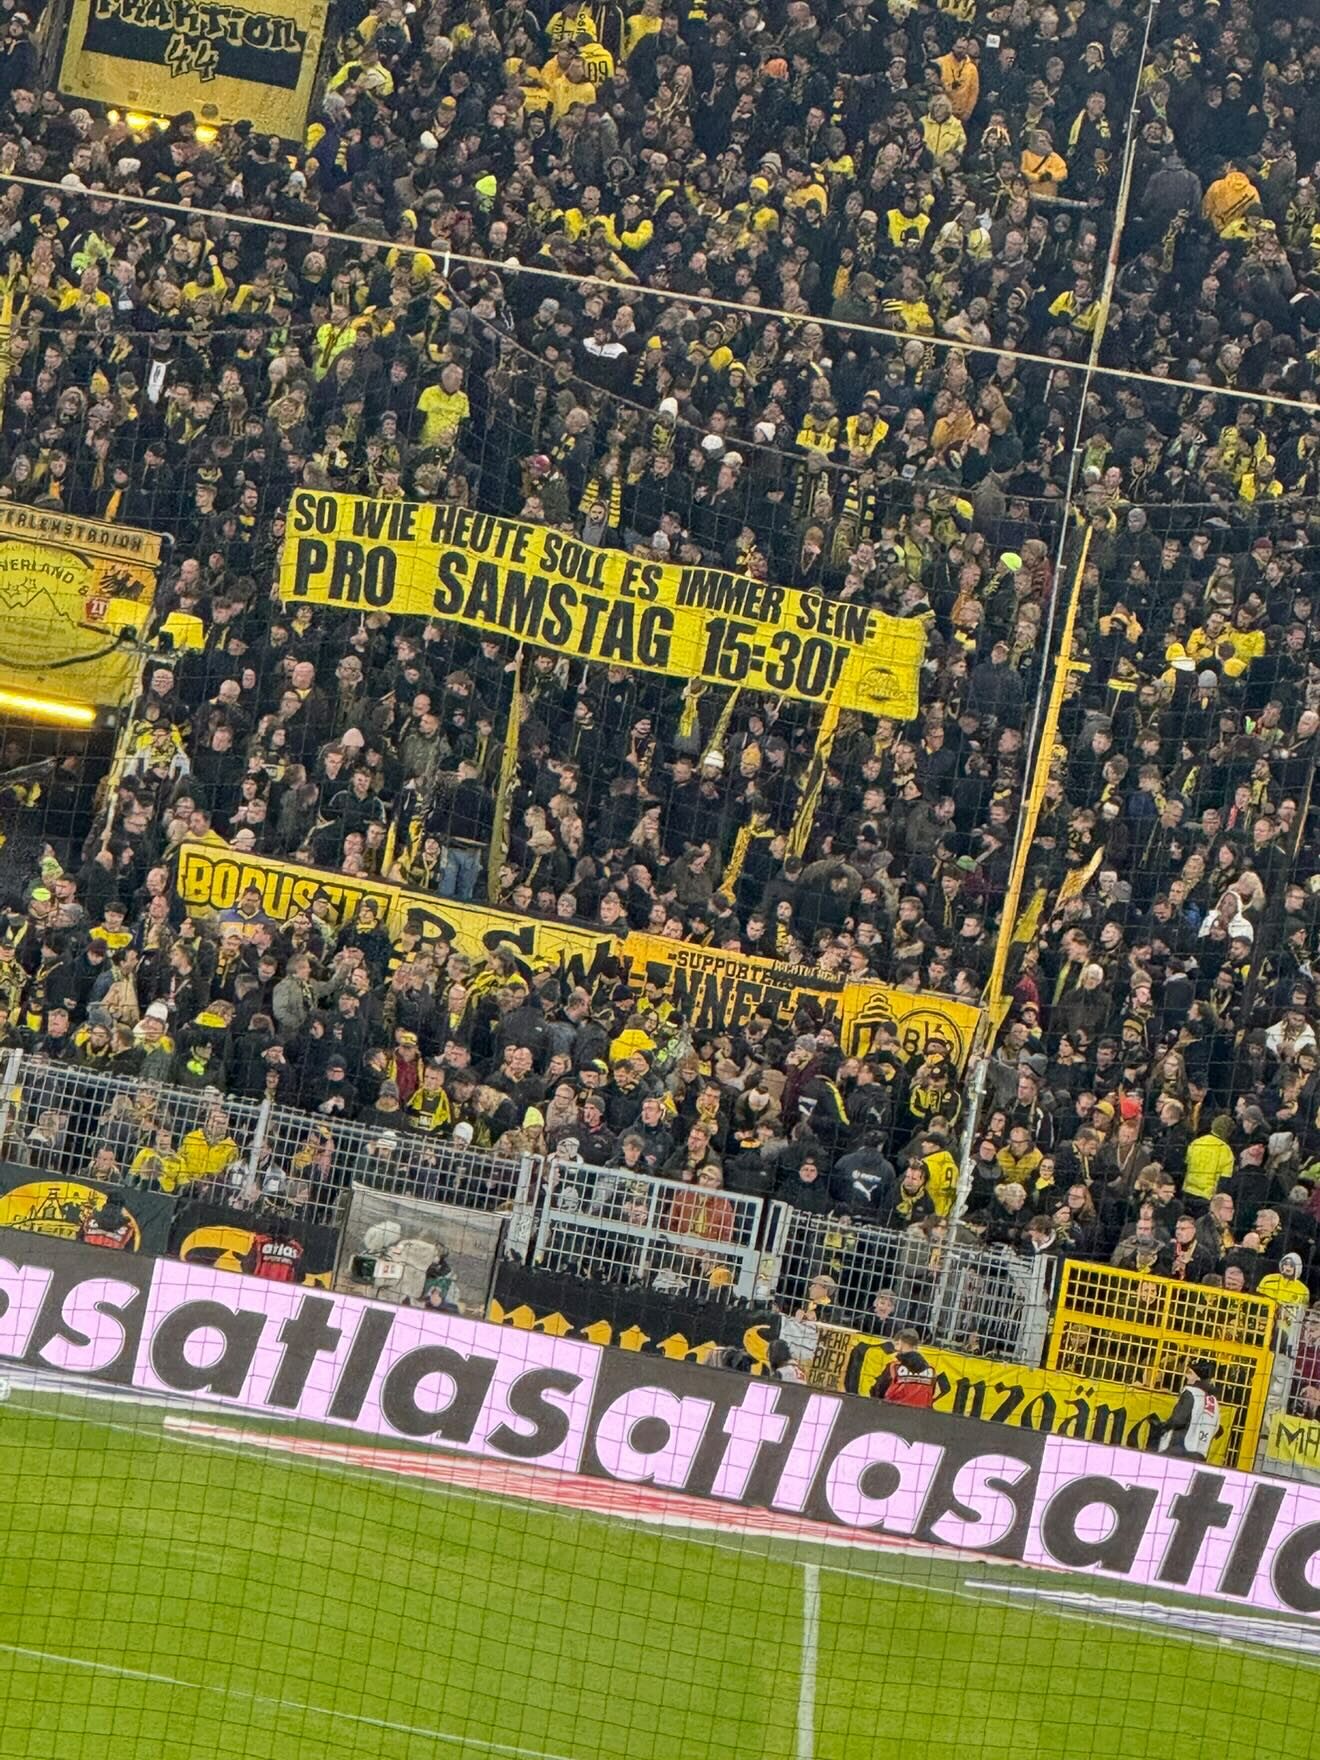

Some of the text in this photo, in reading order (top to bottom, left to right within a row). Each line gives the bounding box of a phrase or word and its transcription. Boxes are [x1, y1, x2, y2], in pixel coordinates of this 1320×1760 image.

[165, 33, 219, 82] 44
[293, 538, 398, 607] PRO
[433, 551, 674, 669] SAMSTAG
[294, 493, 338, 534] SO
[352, 500, 419, 542] WIE
[431, 505, 534, 564] HEUTE
[540, 533, 608, 591] SOLL
[620, 559, 663, 602] ES
[675, 568, 785, 625] IMMER
[148, 1295, 584, 1459] atlas
[812, 1346, 846, 1374] BIER
[816, 1327, 851, 1352] MEHR
[595, 1382, 1031, 1548] atlas
